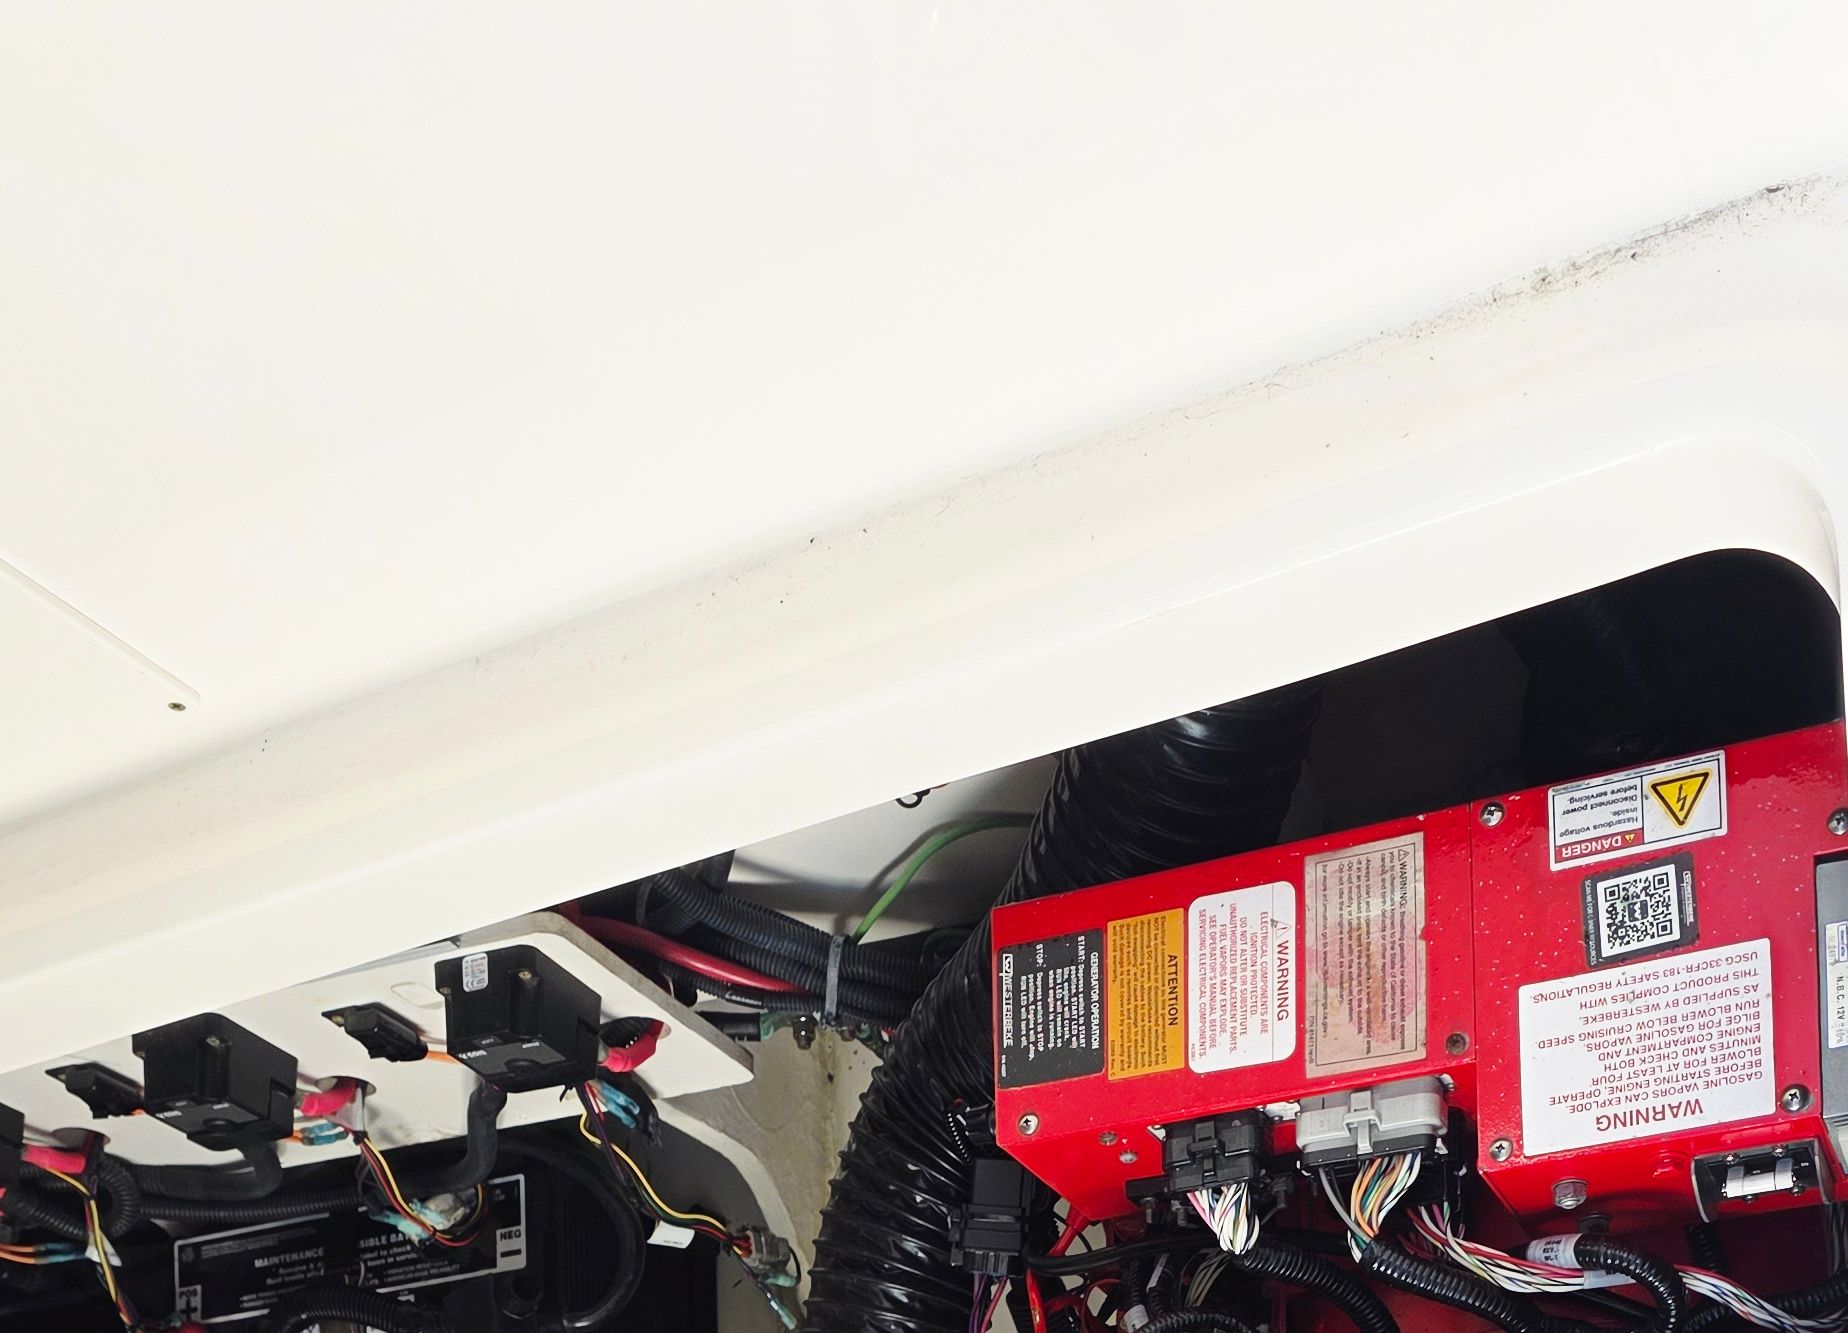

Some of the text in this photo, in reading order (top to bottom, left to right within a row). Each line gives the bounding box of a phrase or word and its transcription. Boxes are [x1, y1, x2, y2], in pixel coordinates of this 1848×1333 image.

[1562, 794, 1637, 815] Disconnect power
[1568, 784, 1637, 803] before servicing.
[1610, 806, 1637, 816] inside.
[1559, 816, 1637, 837] Hazardous voltage
[1562, 835, 1621, 857] DANGER
[1399, 861, 1407, 908] WARNING:
[1077, 935, 1085, 962] START:
[1219, 923, 1227, 942] FUEL
[1035, 943, 1043, 966] STOP:
[1219, 945, 1227, 976] VAPORS
[1249, 932, 1257, 1015] IGNITION PROTECTED.
[1259, 911, 1268, 1034] ELECTRICAL COMPONENTS ARE
[1167, 954, 1178, 1025] ATTENTION
[1198, 908, 1206, 1056] SERVICING ELECTRICAL COMPONENTS.
[1208, 914, 1216, 1048] SEE OPERATOR'S MANUAL BEFORE
[1229, 903, 1237, 1053] UNAUTHORIZED REPLACEMENT PARTS.
[1239, 916, 1247, 1035] DO NOT ALTER OR SUBSTITUTE
[1277, 940, 1288, 1020] WARNING
[1532, 951, 1757, 1003] USCG 33CFR-183 SAFETY REGULATIONS.
[1579, 968, 1758, 1009] THIS PRODUCT COMPLIES WITH
[1743, 983, 1758, 993] AS
[1090, 952, 1099, 1048] GENERATOR OPERATION
[1664, 998, 1679, 1008] BY
[1683, 986, 1739, 1005] SUPPLIED
[1836, 1006, 1845, 1019] 12V
[1219, 998, 1227, 1036] EXPLODE.
[1536, 999, 1759, 1048] RUN BLOWER BELOW CRUISING SPEED.
[1584, 1010, 1759, 1051] BILGE FOR GASOLINE VAPORS.
[1598, 1022, 1760, 1061] ENGINE COMPARTMENT AND
[1604, 1035, 1760, 1071] MINUTES AND CHECK BOTH
[1549, 1058, 1761, 1105] BEFORE STARTING ENGINE, OPERATE
[1591, 1046, 1761, 1085] BLOWER FOR AT LEAST FOUR
[1567, 1070, 1762, 1113] GASOLINE VAPORS CAN EXPLODE.
[1596, 1099, 1702, 1130] WARNING
[499, 1228, 521, 1240] NEG
[254, 1248, 322, 1267] MAINTENANCE
